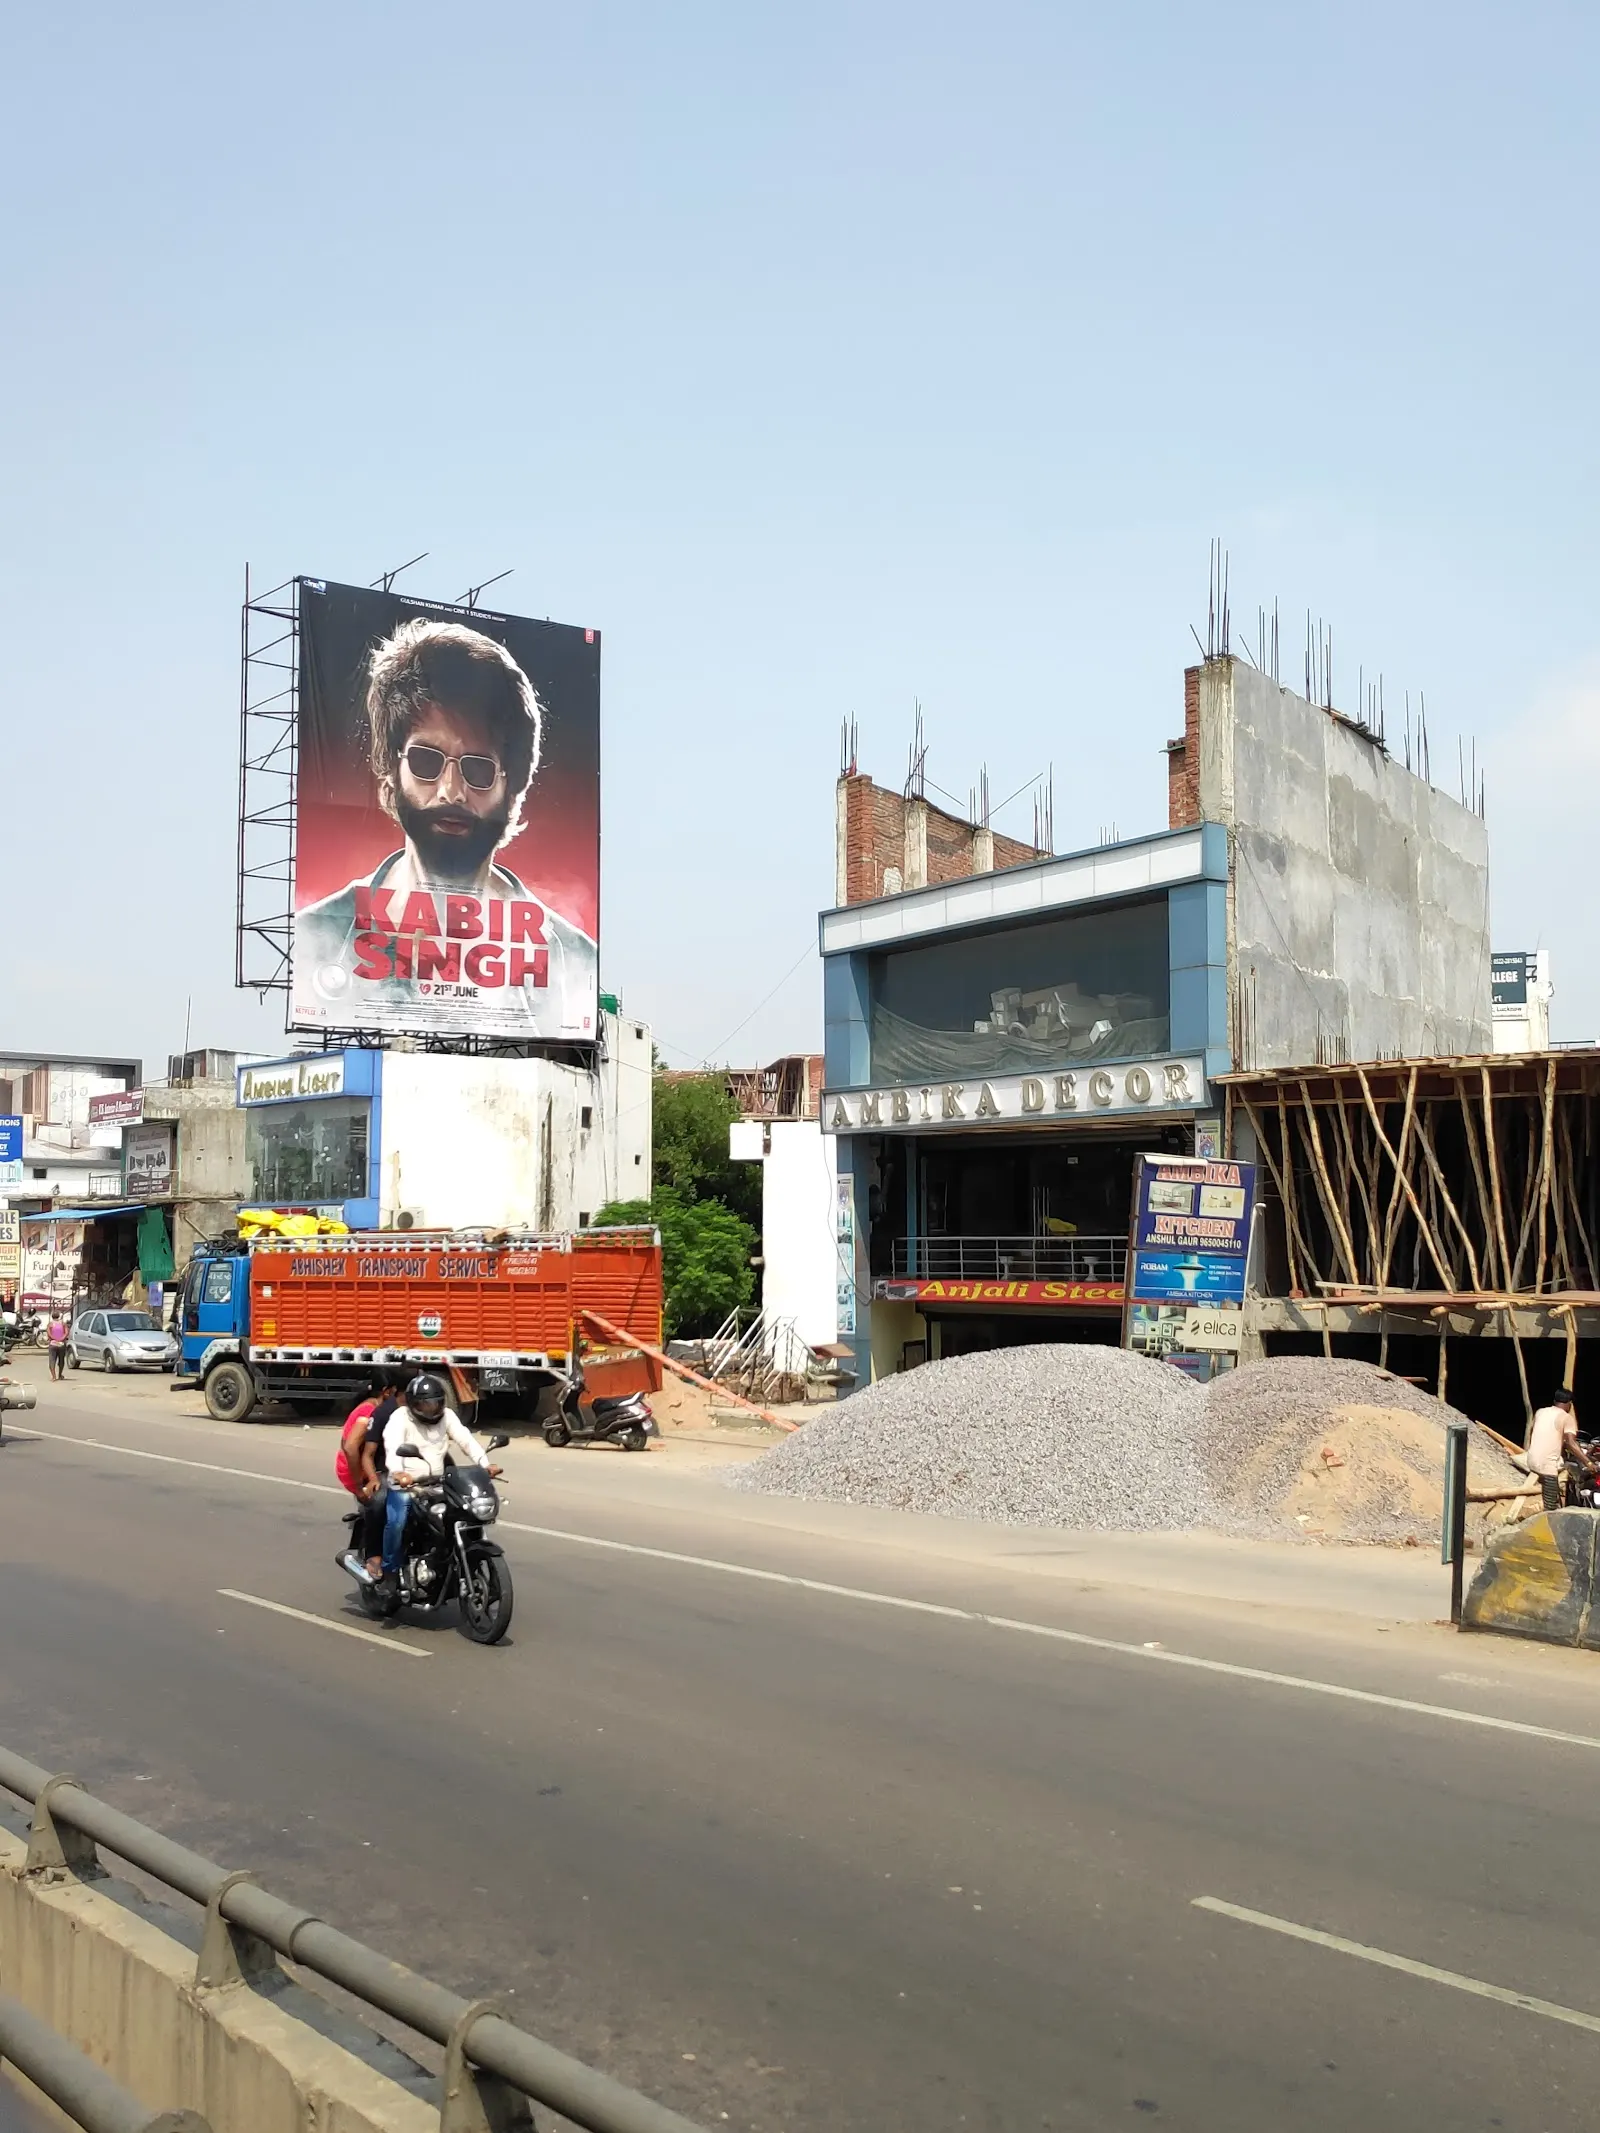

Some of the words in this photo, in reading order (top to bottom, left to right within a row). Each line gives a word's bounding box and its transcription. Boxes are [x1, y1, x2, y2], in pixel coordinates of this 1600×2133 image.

[425, 602, 444, 611] KUMAR
[355, 886, 549, 945] KABIR
[353, 932, 549, 988] SINGH
[453, 985, 479, 998] JUNE
[830, 1082, 1000, 1127] AMBIKA
[1020, 1063, 1193, 1112] DECOR
[1156, 1163, 1241, 1185] AMBIKA
[1155, 1215, 1236, 1238] KITCHEN
[1145, 1233, 1176, 1245] ANSHUL
[1177, 1235, 1198, 1246] GAUR
[290, 1258, 347, 1277] ABHISHEK
[356, 1257, 430, 1278] TRANSPORT
[437, 1256, 499, 1279] SERVICE
[919, 1281, 1030, 1300] Anjali
[1203, 1320, 1237, 1336] elica
